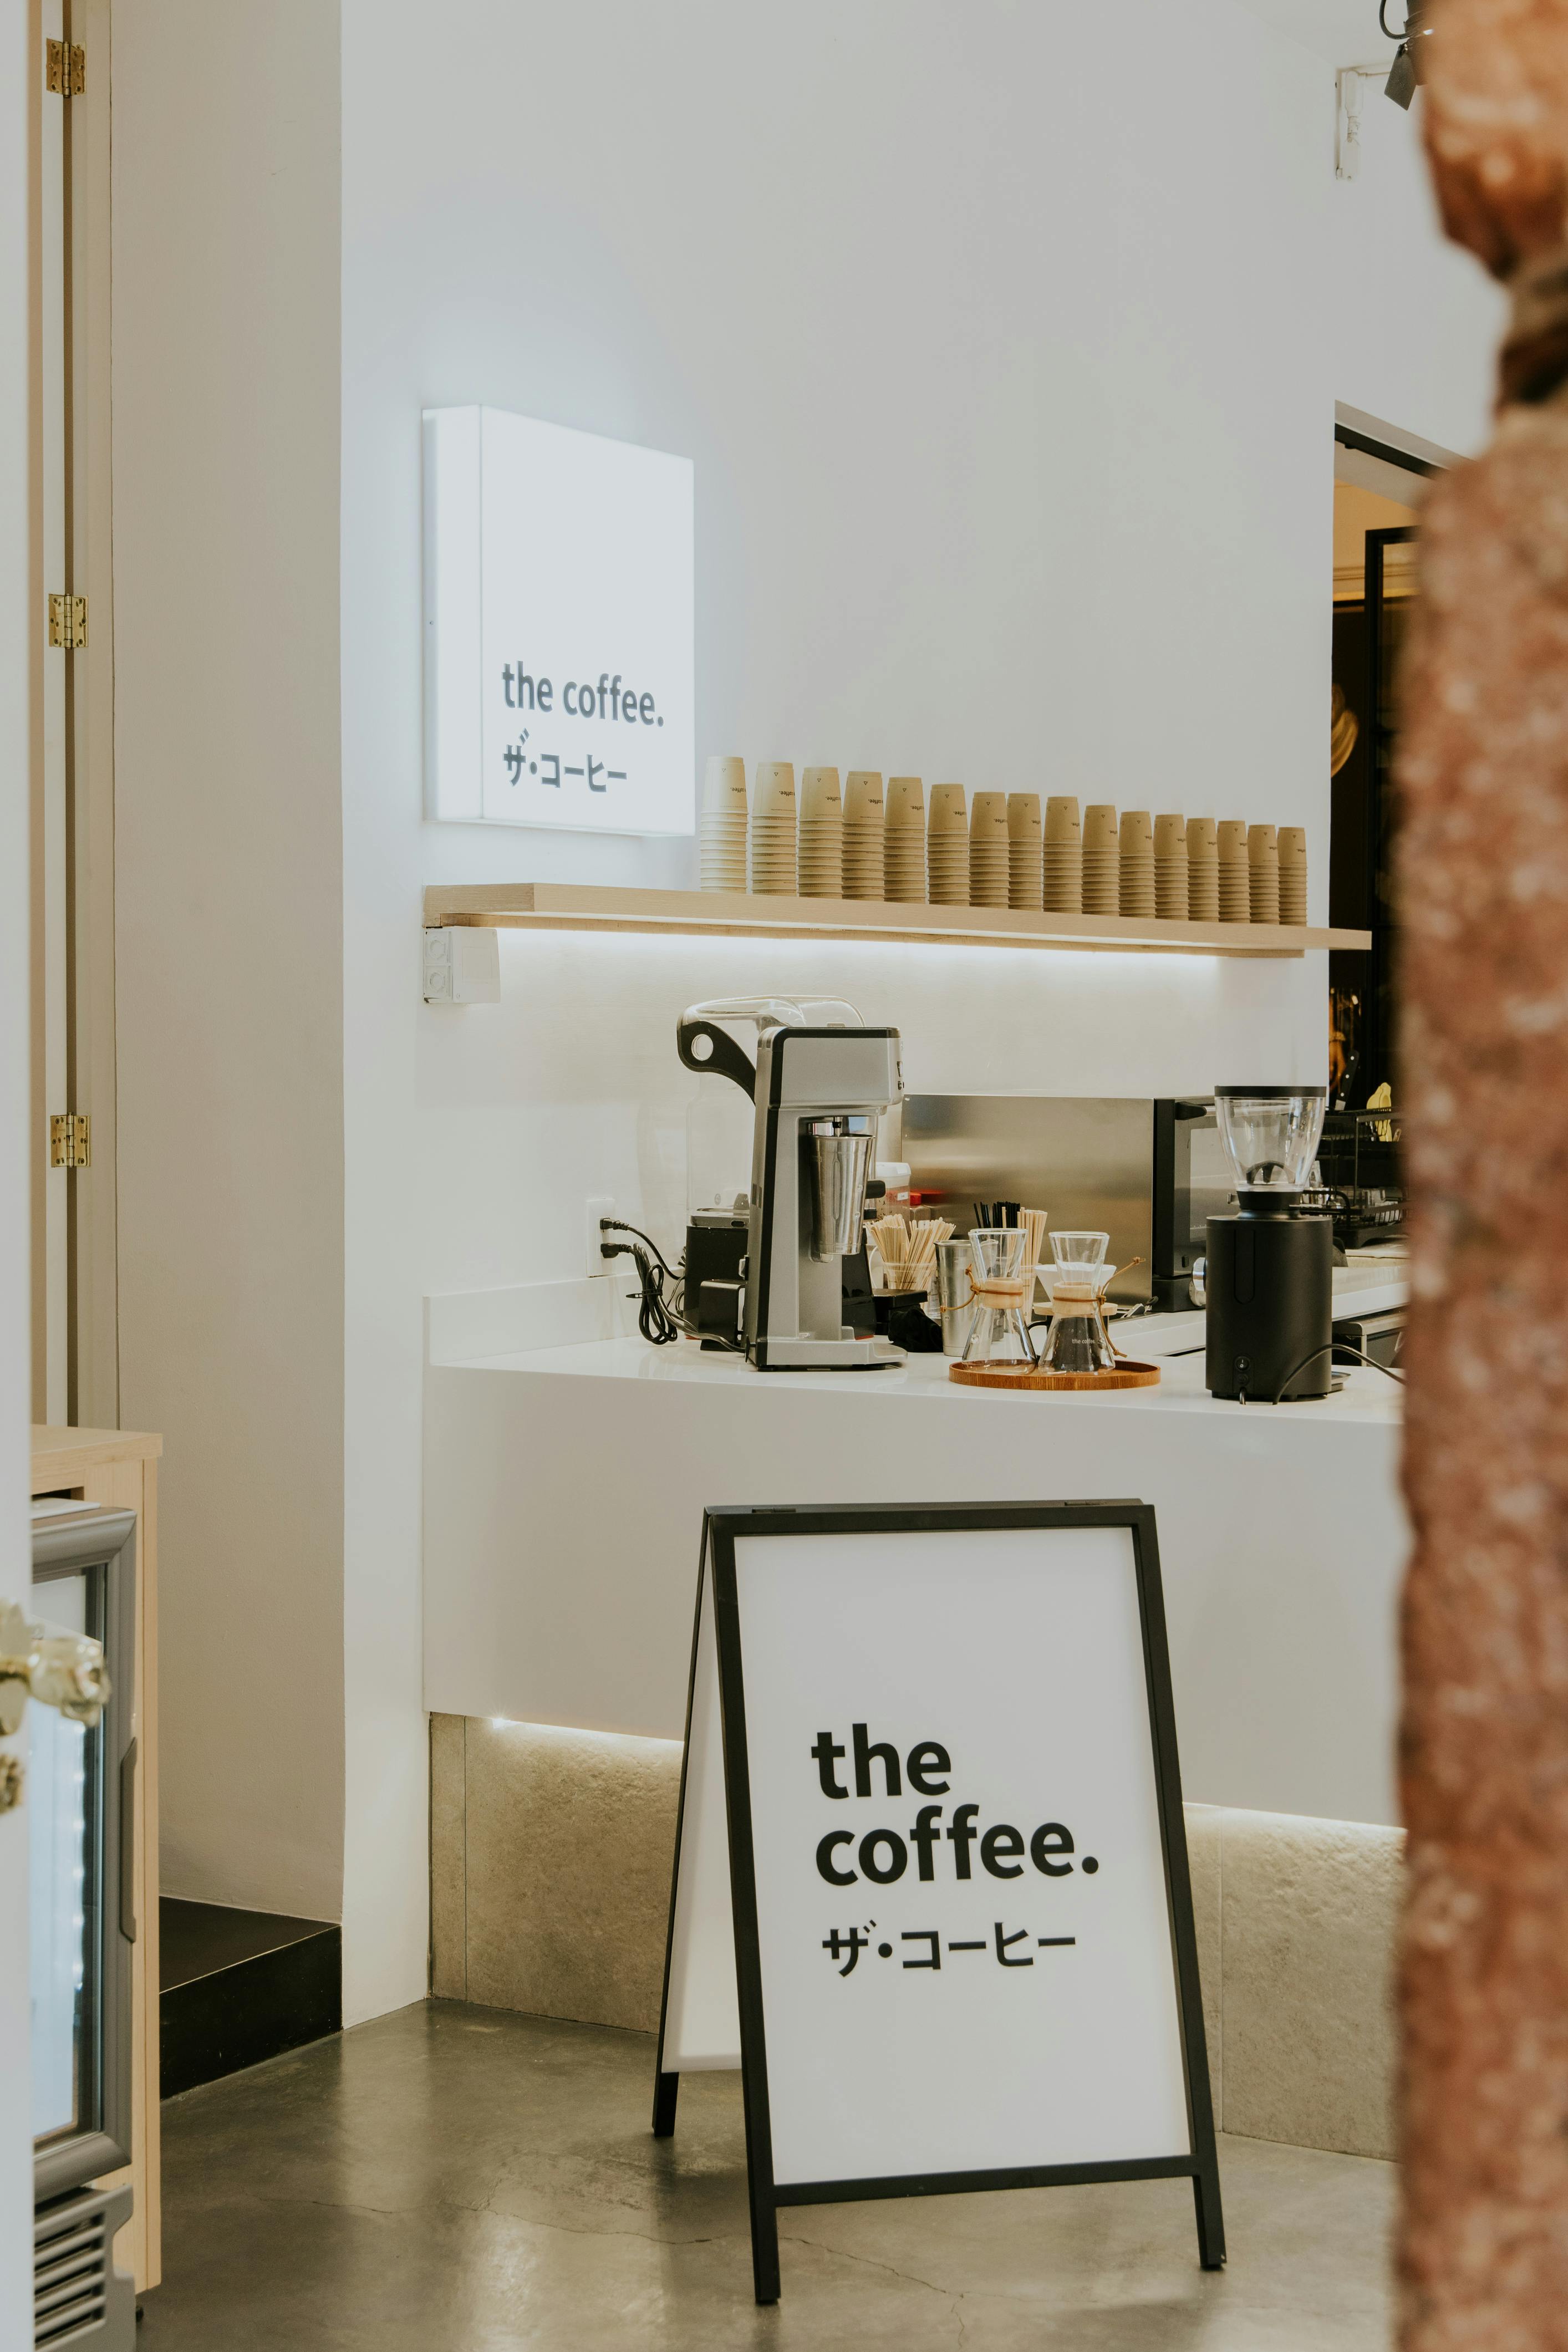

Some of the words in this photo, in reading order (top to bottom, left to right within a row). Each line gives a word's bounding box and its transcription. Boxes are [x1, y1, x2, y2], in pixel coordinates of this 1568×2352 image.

[502, 660, 553, 712] the
[563, 673, 664, 727] coffee.
[503, 728, 627, 793] ザ・コーヒー
[811, 1723, 952, 1800] the
[816, 1804, 1099, 1886] coffee.
[822, 1920, 1076, 1978] ザ・コーヒー
